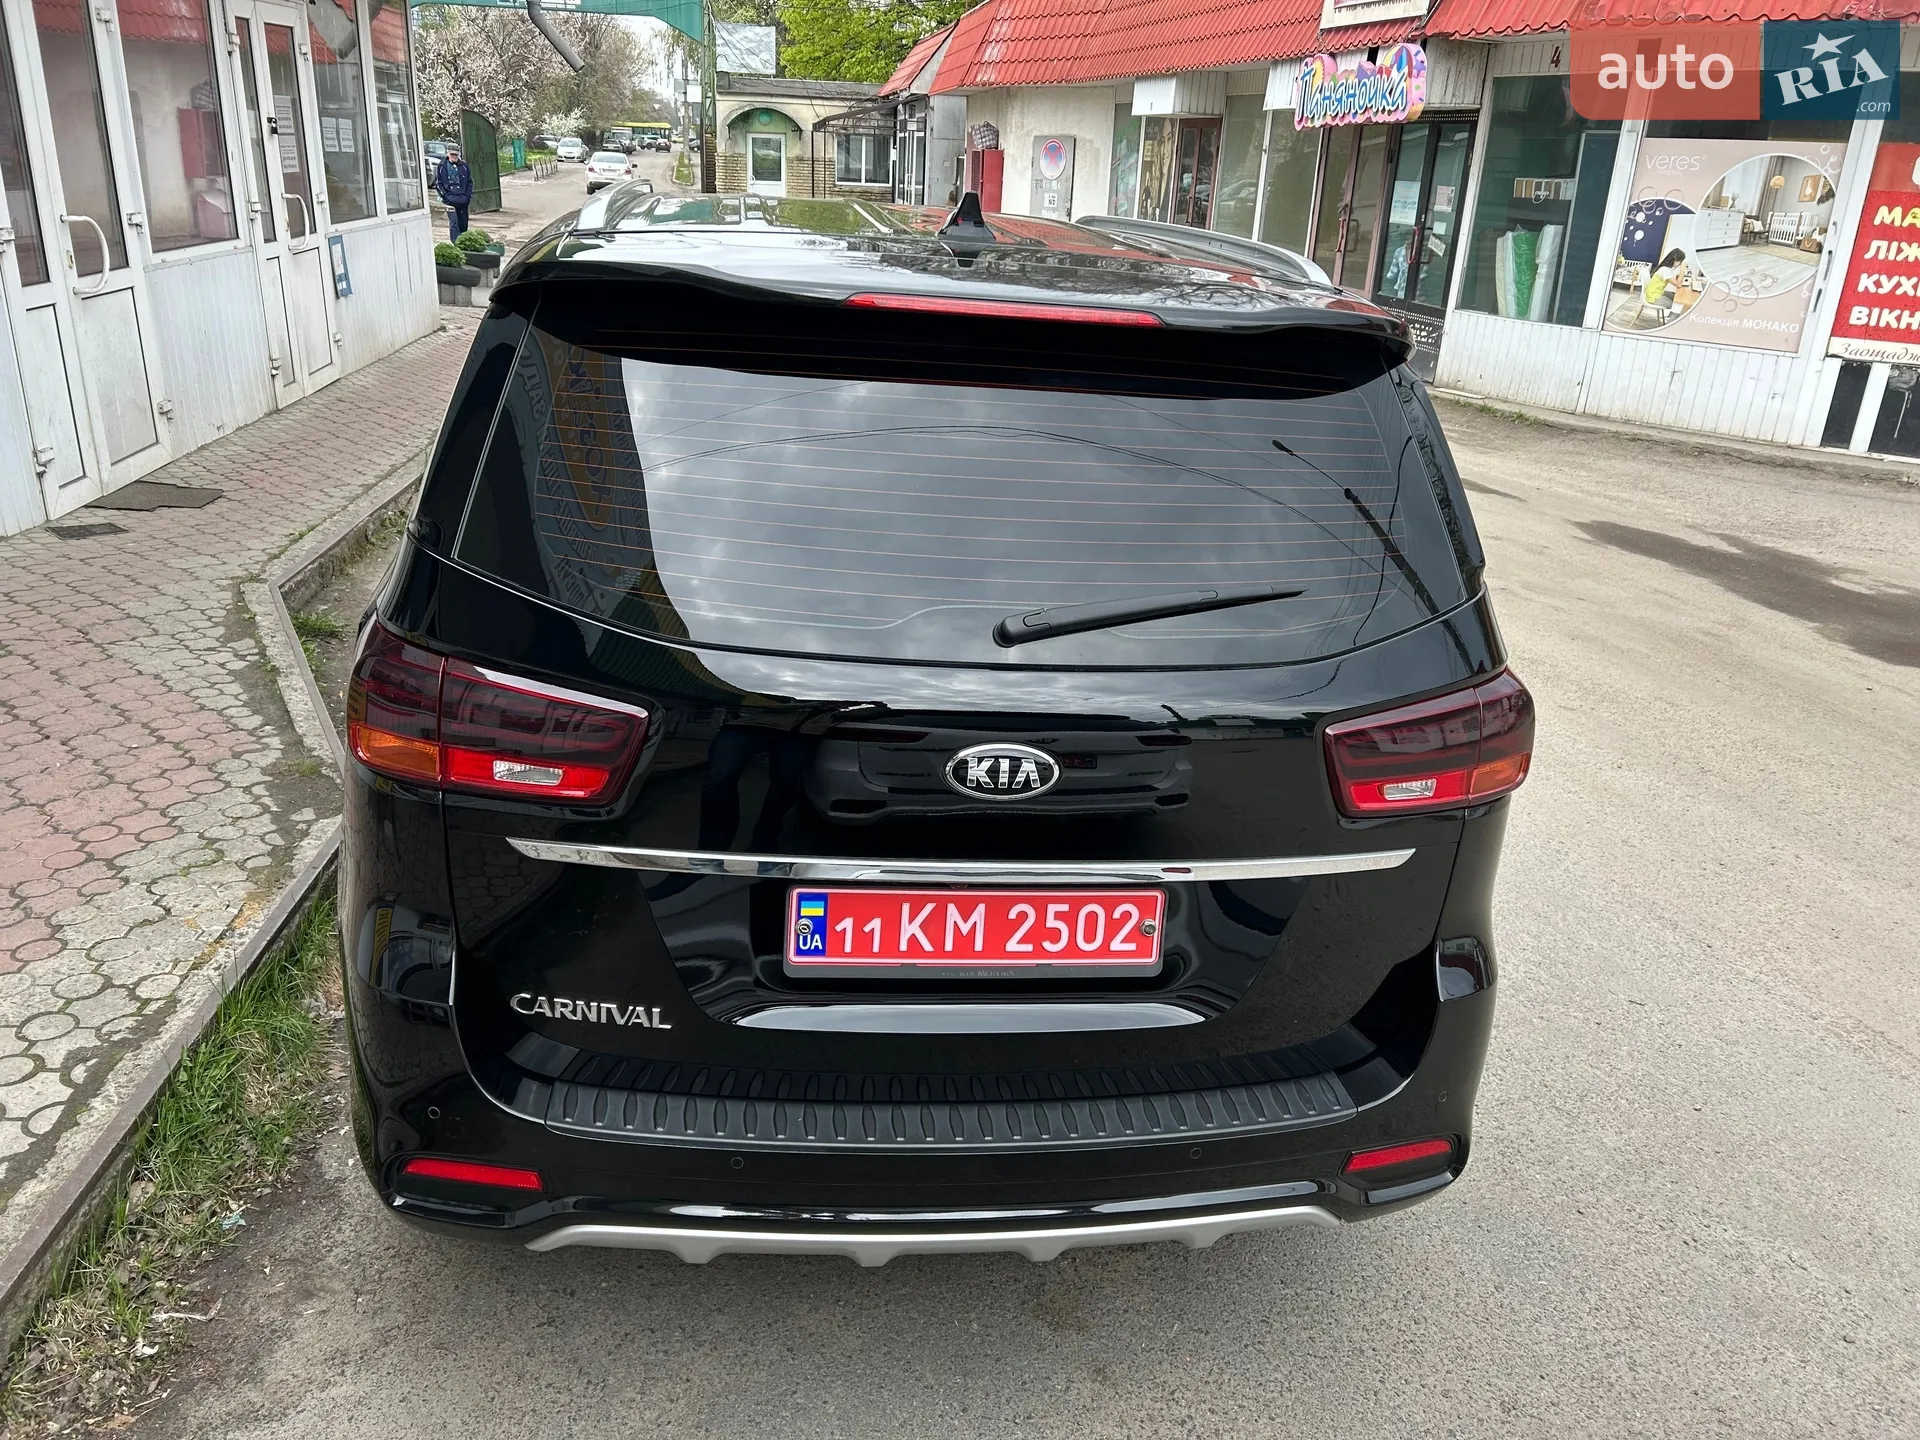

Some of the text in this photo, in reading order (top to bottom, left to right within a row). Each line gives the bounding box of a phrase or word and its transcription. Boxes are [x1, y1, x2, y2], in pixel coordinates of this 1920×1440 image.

[1550, 45, 1562, 68] 4
[1296, 64, 1410, 125] Паняночка
[1857, 272, 1920, 298] КУХ
[1690, 313, 1800, 334] Колекція МОНАКО
[966, 757, 1041, 789] KIA
[833, 917, 881, 953] 11
[1004, 902, 1141, 952] 2502
[799, 935, 823, 951] UA
[509, 992, 673, 1030] CARNIVAL
